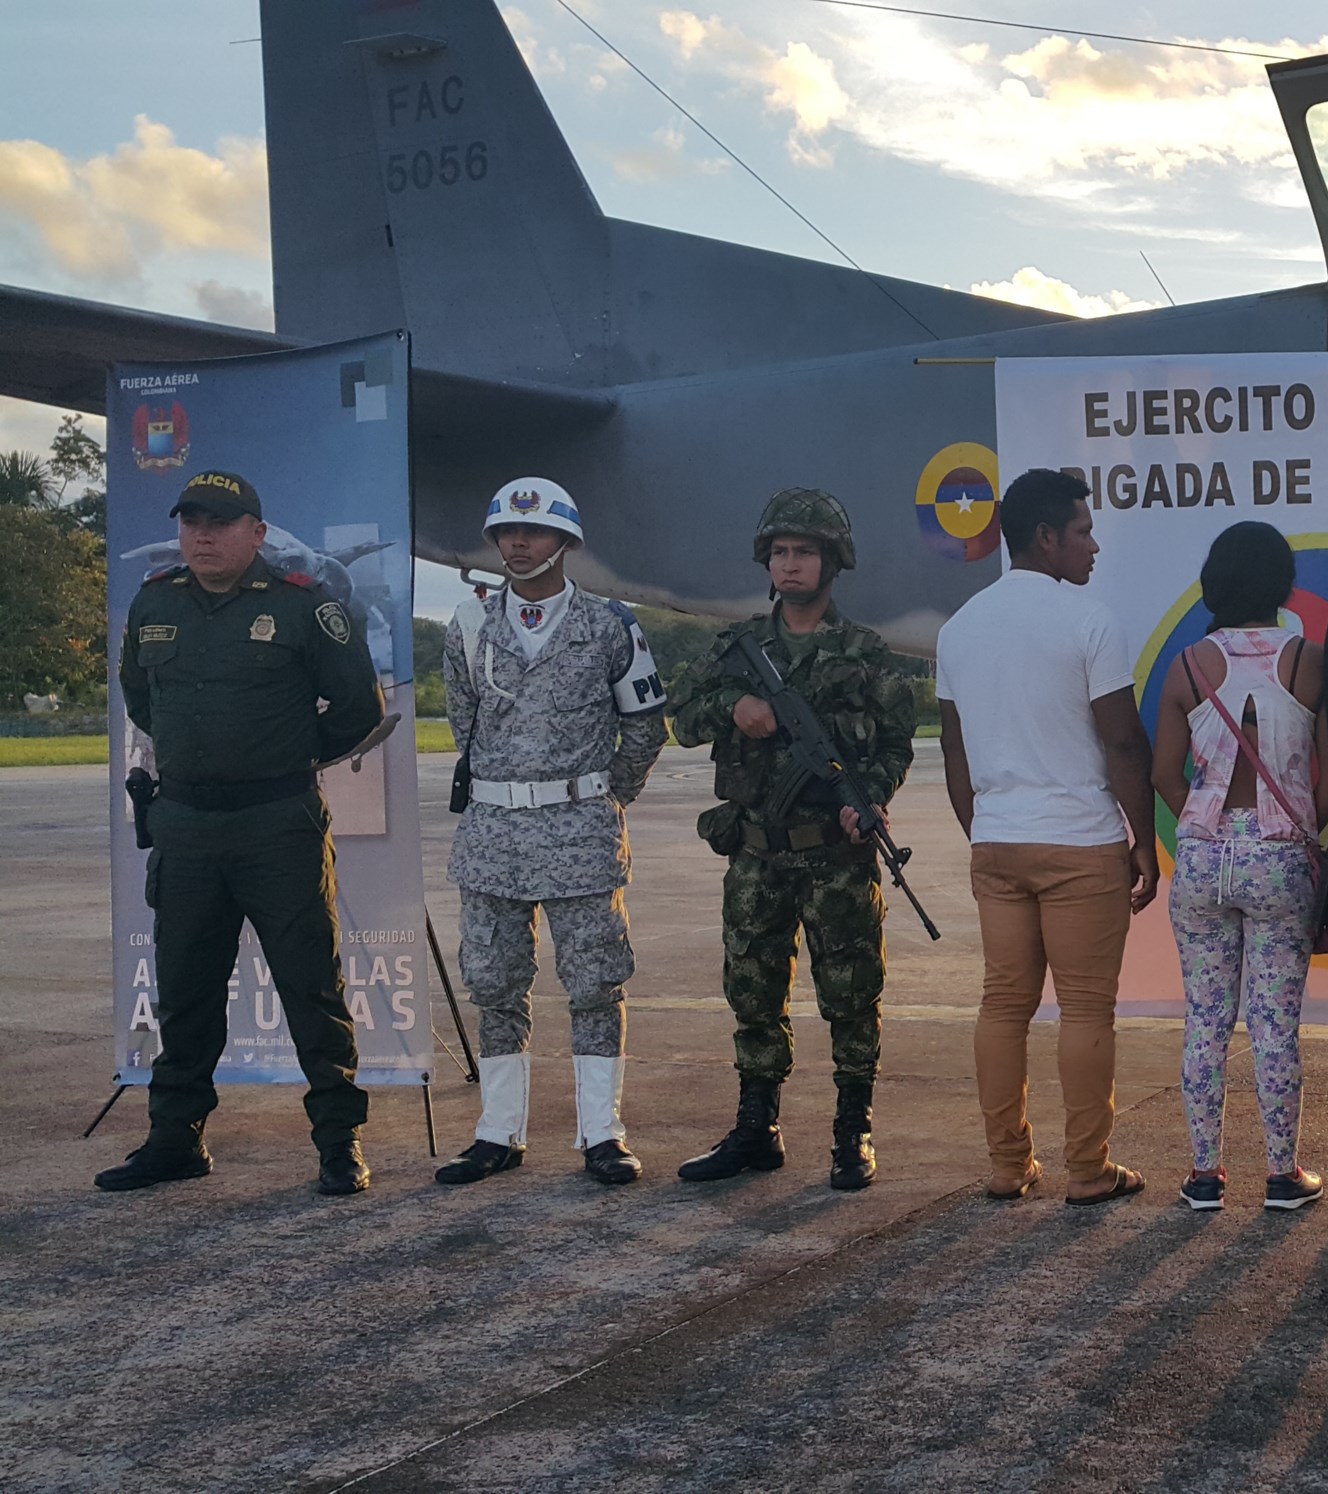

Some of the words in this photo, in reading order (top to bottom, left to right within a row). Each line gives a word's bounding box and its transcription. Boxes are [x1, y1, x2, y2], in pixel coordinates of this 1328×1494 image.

[387, 75, 464, 128] FAC
[386, 141, 489, 194] 5056
[120, 376, 162, 389] FUERZA
[164, 373, 200, 386] AÉREA
[1084, 383, 1315, 437] EJERCITO
[184, 474, 240, 495] OLICIA
[1252, 458, 1312, 505] DE
[348, 930, 415, 943] SEGURIDAD
[349, 956, 414, 986] LAS
